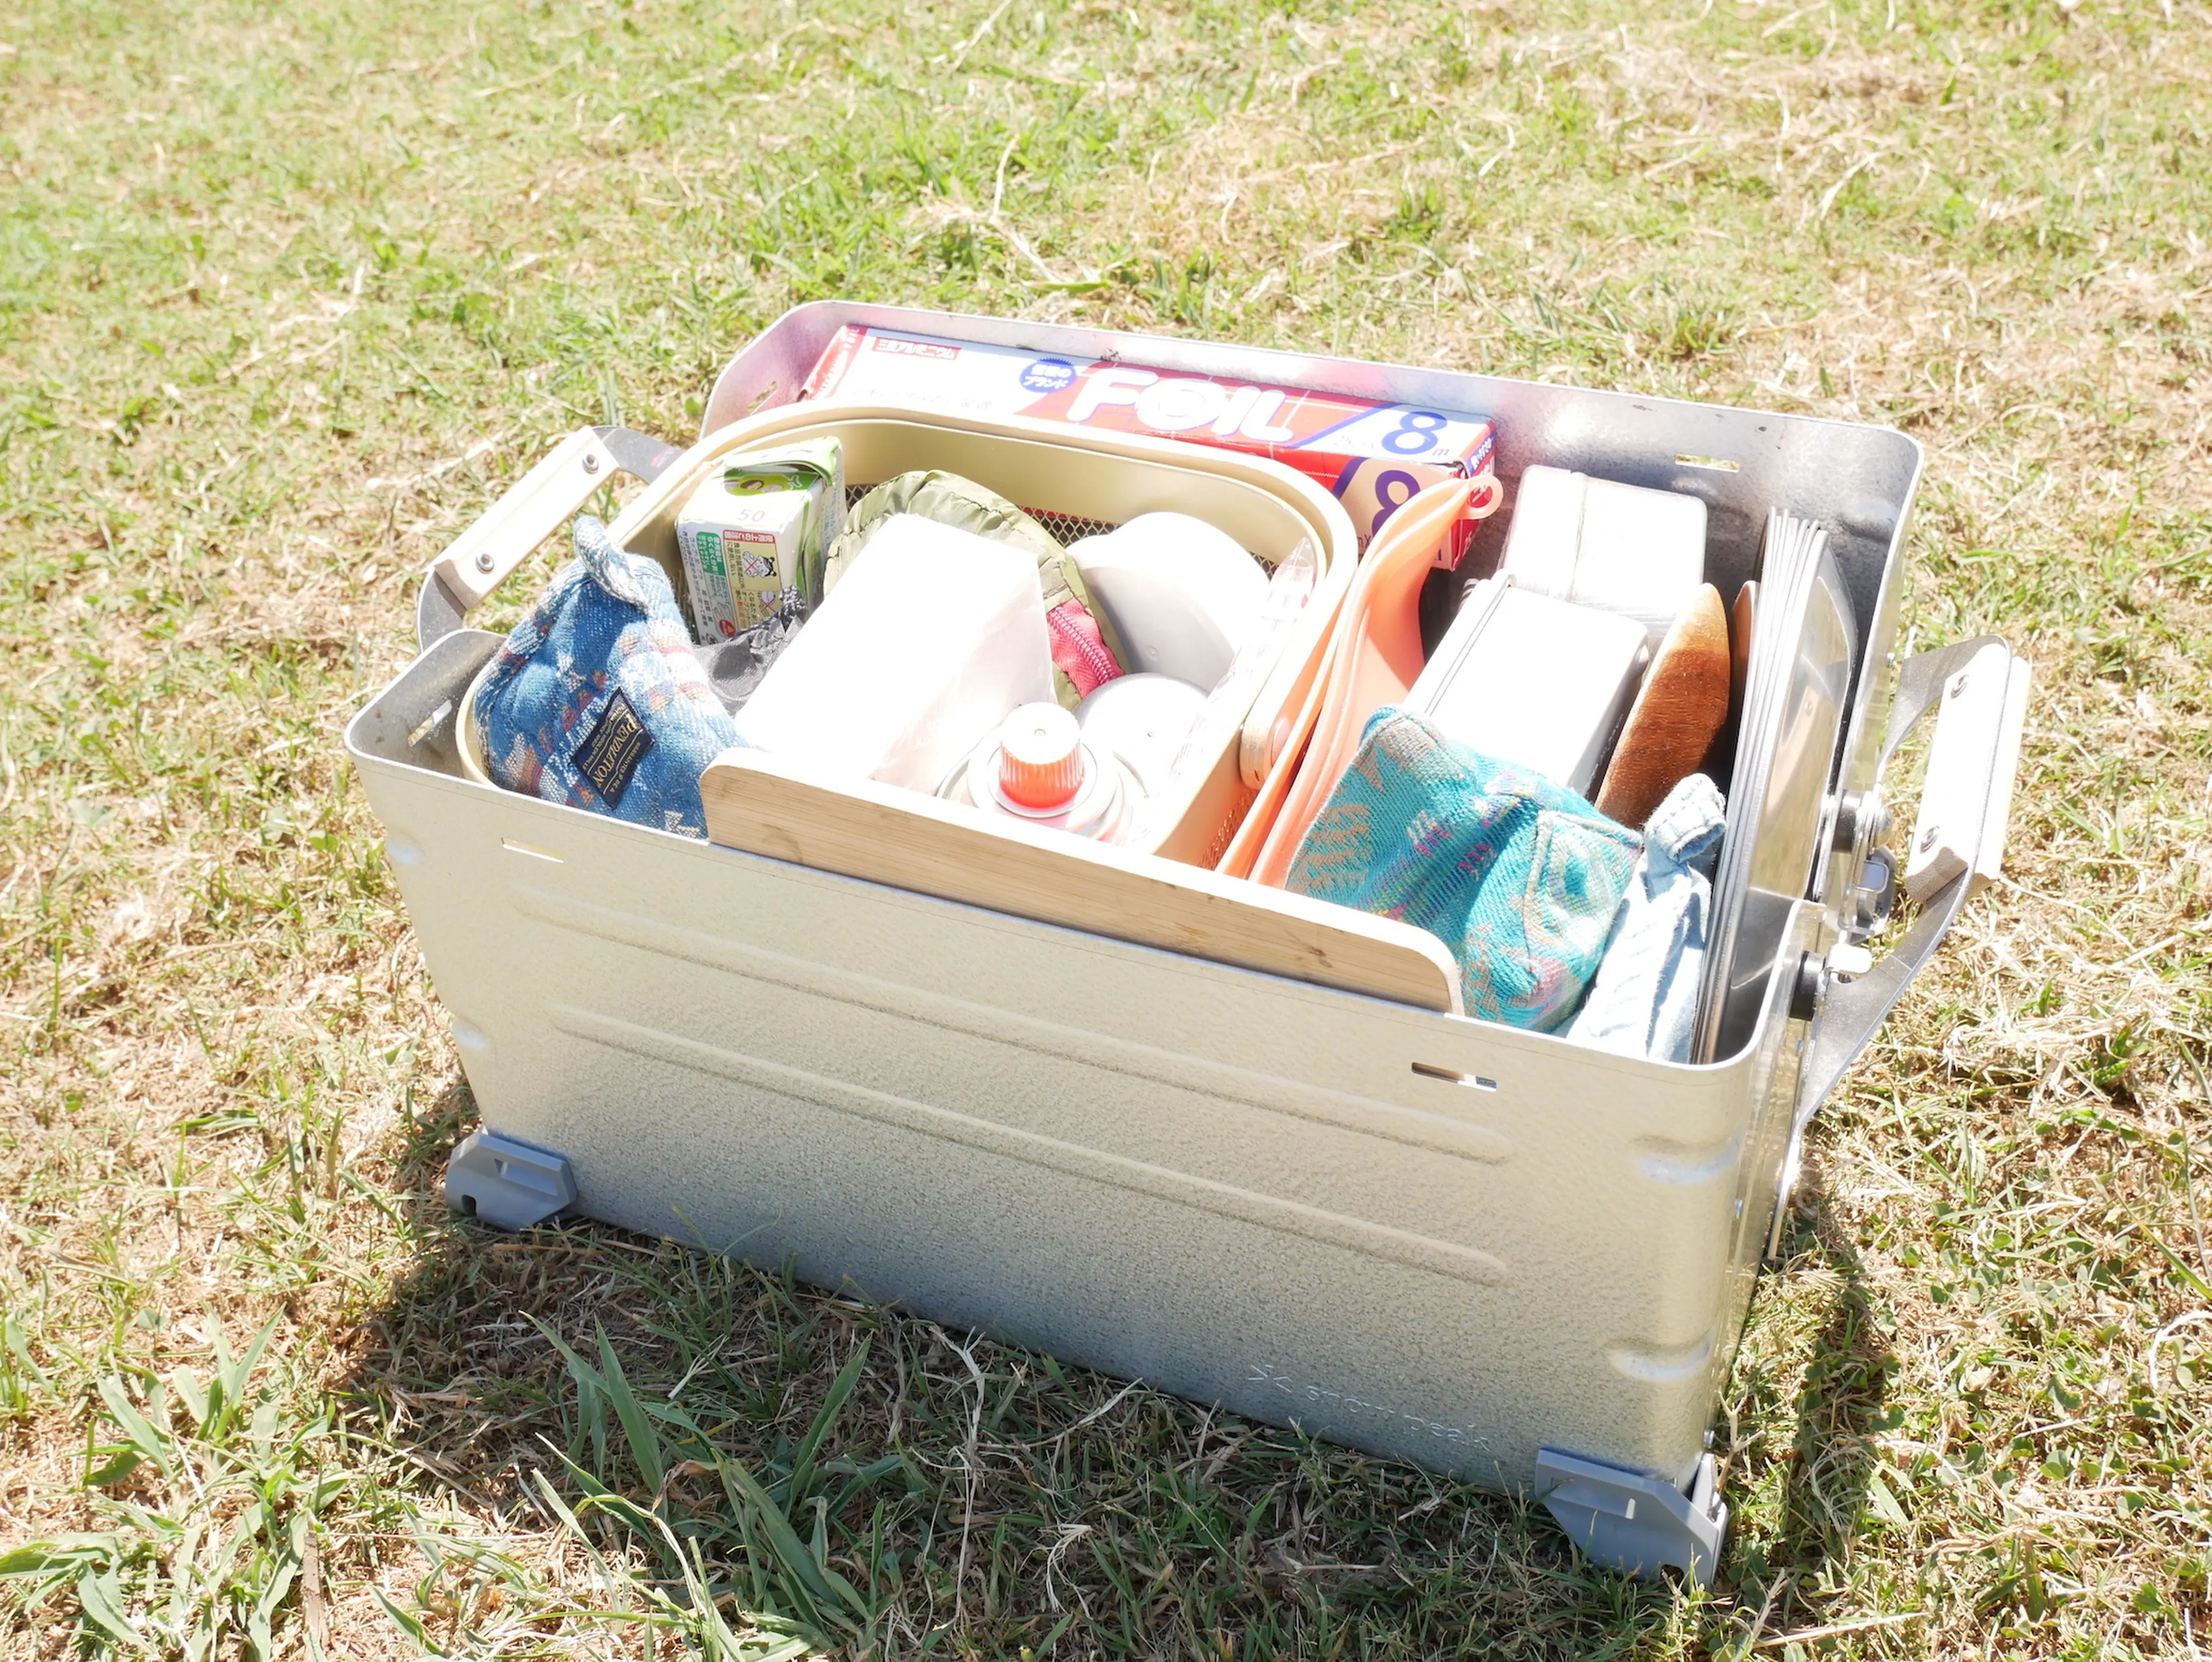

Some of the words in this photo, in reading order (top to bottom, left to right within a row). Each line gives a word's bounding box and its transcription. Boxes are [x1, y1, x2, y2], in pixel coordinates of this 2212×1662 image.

[1023, 376, 1069, 388] ブランド
[1066, 368, 1294, 442] FOIL
[737, 509, 765, 522] 50
[592, 714, 637, 784] PENDLETON
